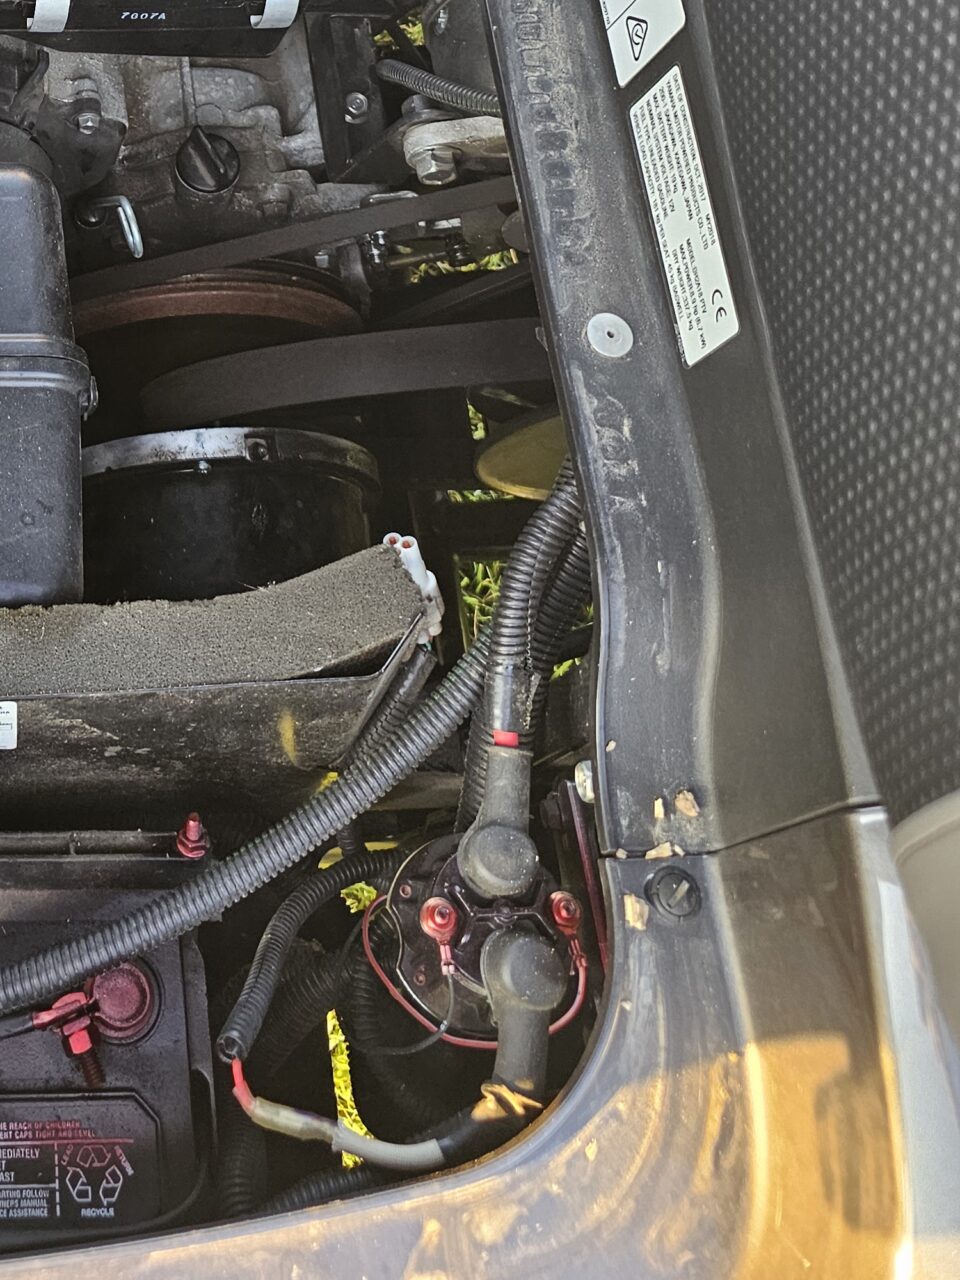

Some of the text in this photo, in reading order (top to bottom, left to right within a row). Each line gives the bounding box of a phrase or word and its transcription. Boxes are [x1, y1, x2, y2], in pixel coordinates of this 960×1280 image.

[644, 97, 657, 133] NOMINAL
[652, 130, 663, 163] SYSTEM
[655, 110, 667, 144] BATTERY
[665, 78, 677, 111] YAMAHA
[672, 109, 683, 139] MOTOR
[678, 136, 692, 176] POWERED
[686, 173, 701, 217] PRODUCTS
[671, 71, 681, 94] DATE
[697, 181, 706, 203] 2017
[704, 212, 716, 246] MY2018
[631, 110, 643, 141] VEHICLE
[638, 139, 647, 161] LOAD
[657, 222, 665, 240] PER
[638, 104, 647, 125] FUEL
[647, 143, 660, 184] UNLEADED
[655, 181, 669, 220] GASOLINE
[683, 193, 694, 221] JAPAN
[671, 247, 680, 266] DRY
[709, 285, 728, 324] CE
[9, 1122, 32, 1131] REACH
[14, 1130, 33, 1140] CAPS
[20, 1198, 47, 1207] MANUAL
[22, 1189, 50, 1198] FOLLOW
[9, 1207, 48, 1217] ASSISTANCE
[81, 1207, 115, 1217] RECYCLE
